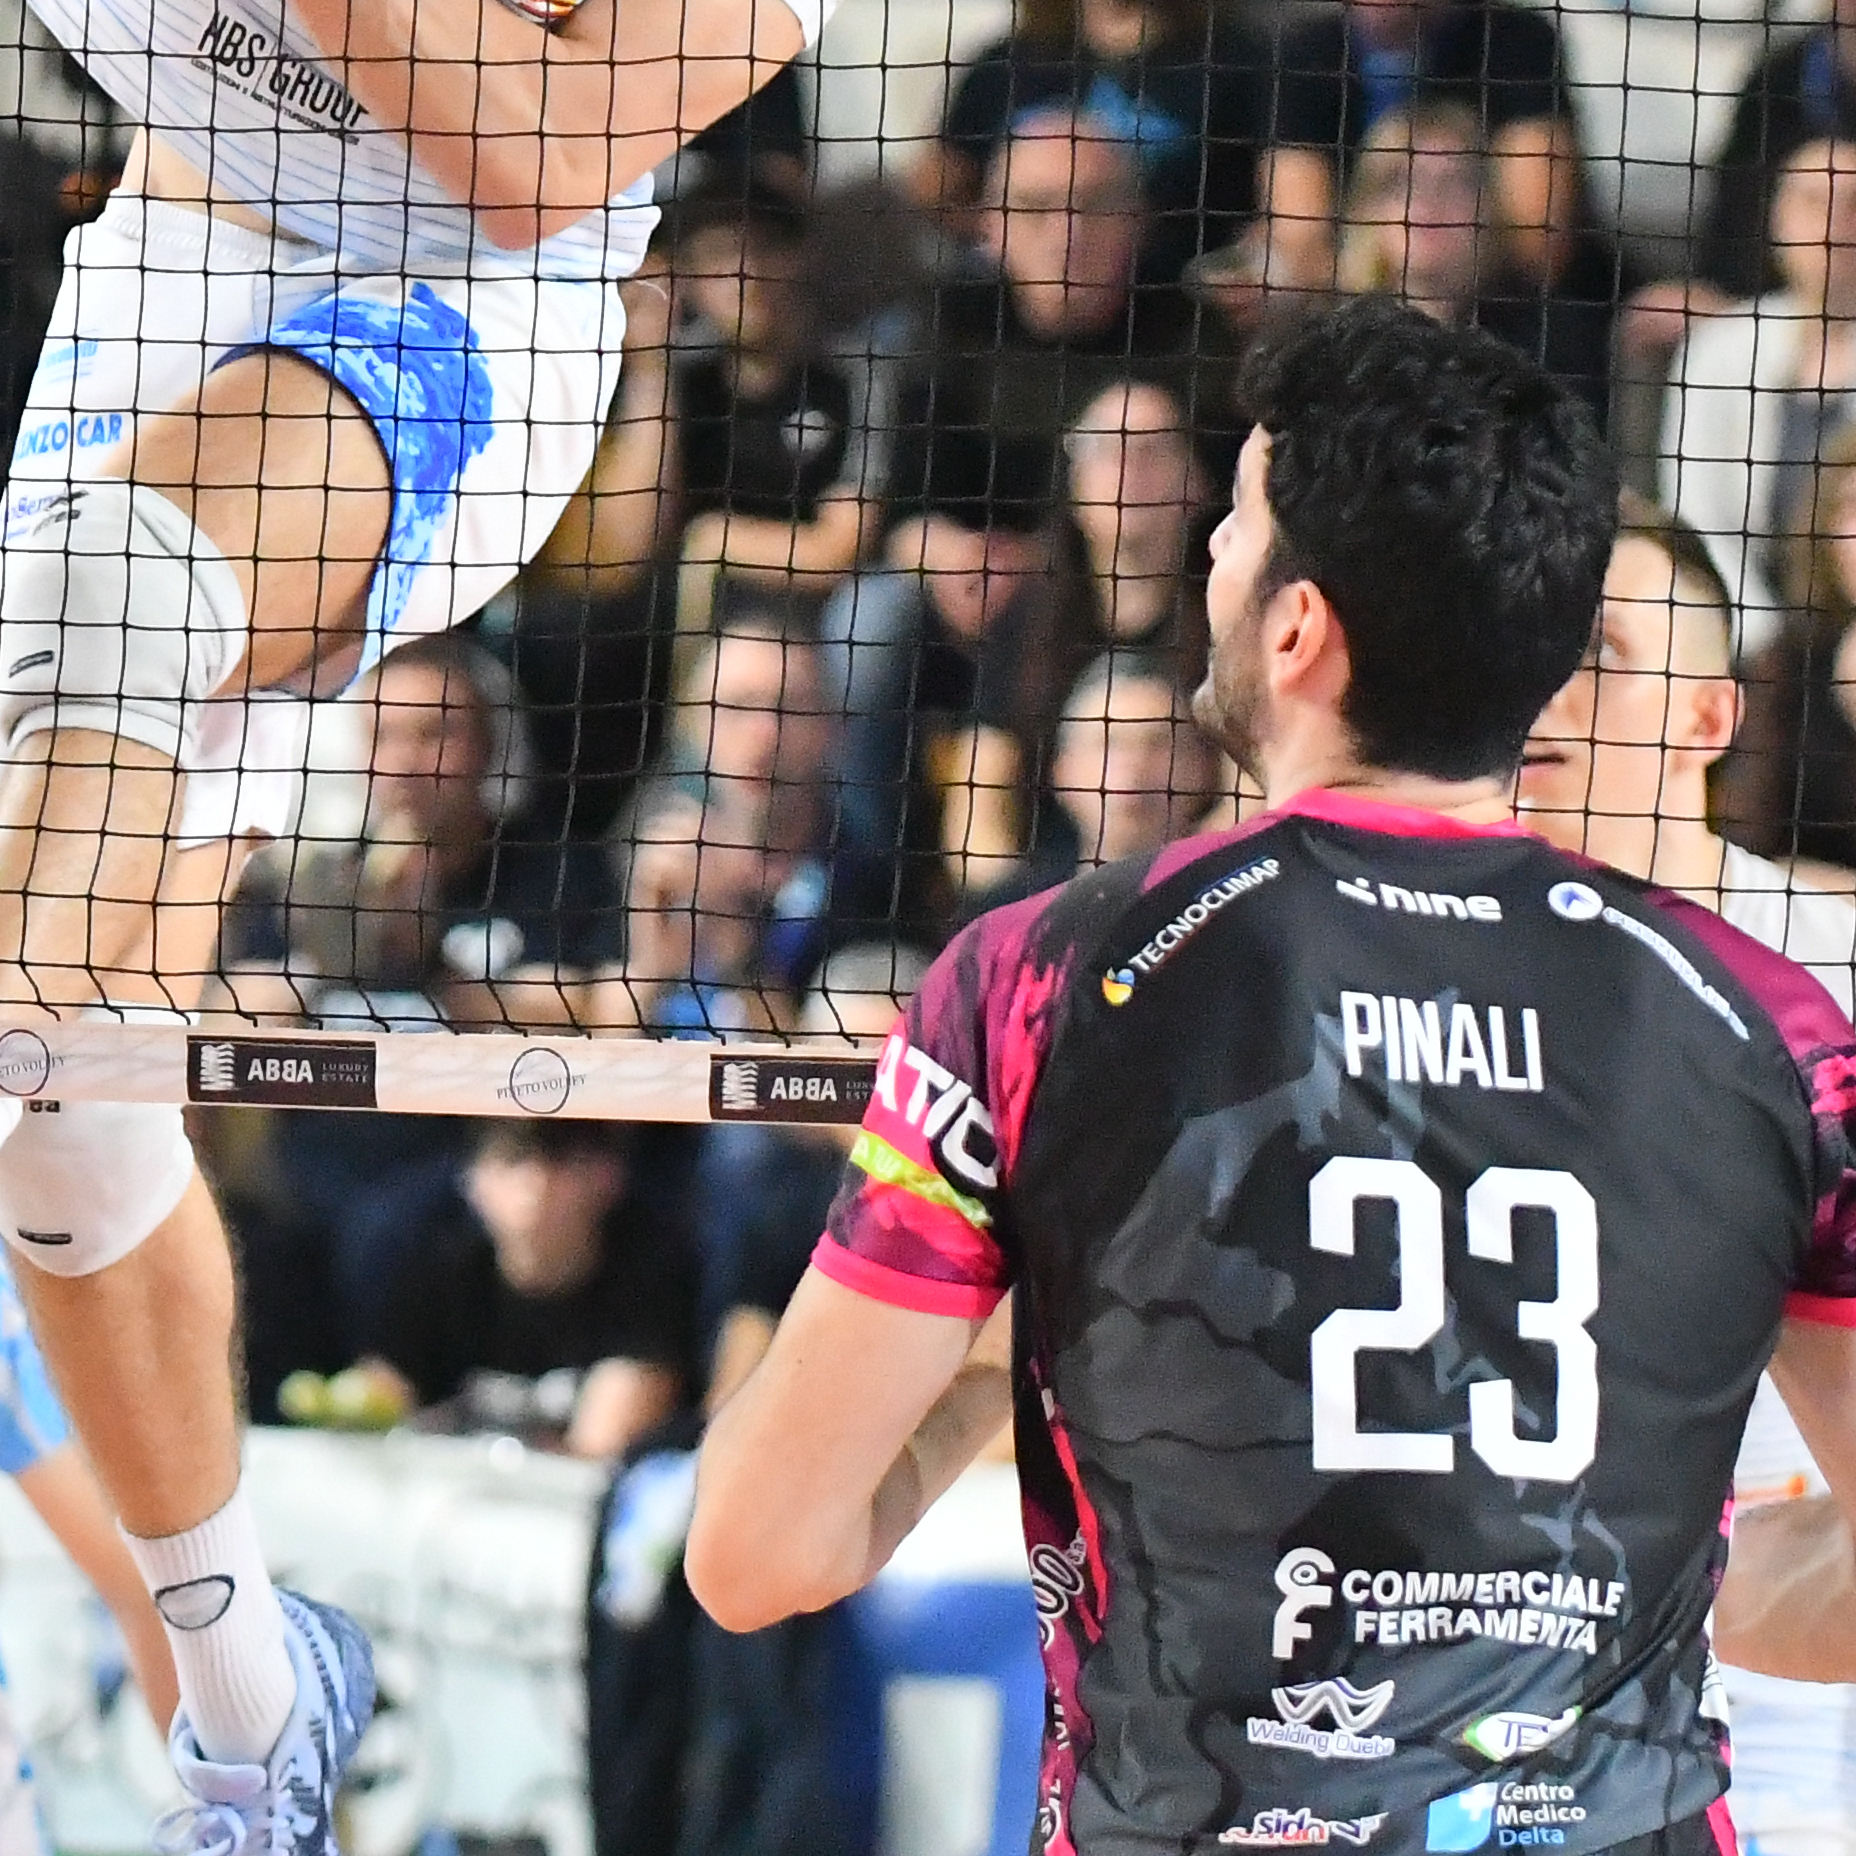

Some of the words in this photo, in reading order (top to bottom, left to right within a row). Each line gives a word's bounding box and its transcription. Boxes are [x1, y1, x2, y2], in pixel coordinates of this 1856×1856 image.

[77, 413, 123, 448] CAR
[1377, 885, 1502, 922] nine
[1341, 989, 1544, 1093] PINALI
[247, 1059, 313, 1083] ABBA
[771, 1077, 837, 1101] ABBA
[1308, 1156, 1602, 1484] 23
[1341, 1568, 1625, 1617] COMMERCIALE
[1354, 1606, 1598, 1655] FERRAMENTA
[1250, 1721, 1329, 1753] Welding
[1501, 1781, 1575, 1801] Centro
[1497, 1803, 1587, 1826] Medico
[1499, 1828, 1565, 1846] Delta
